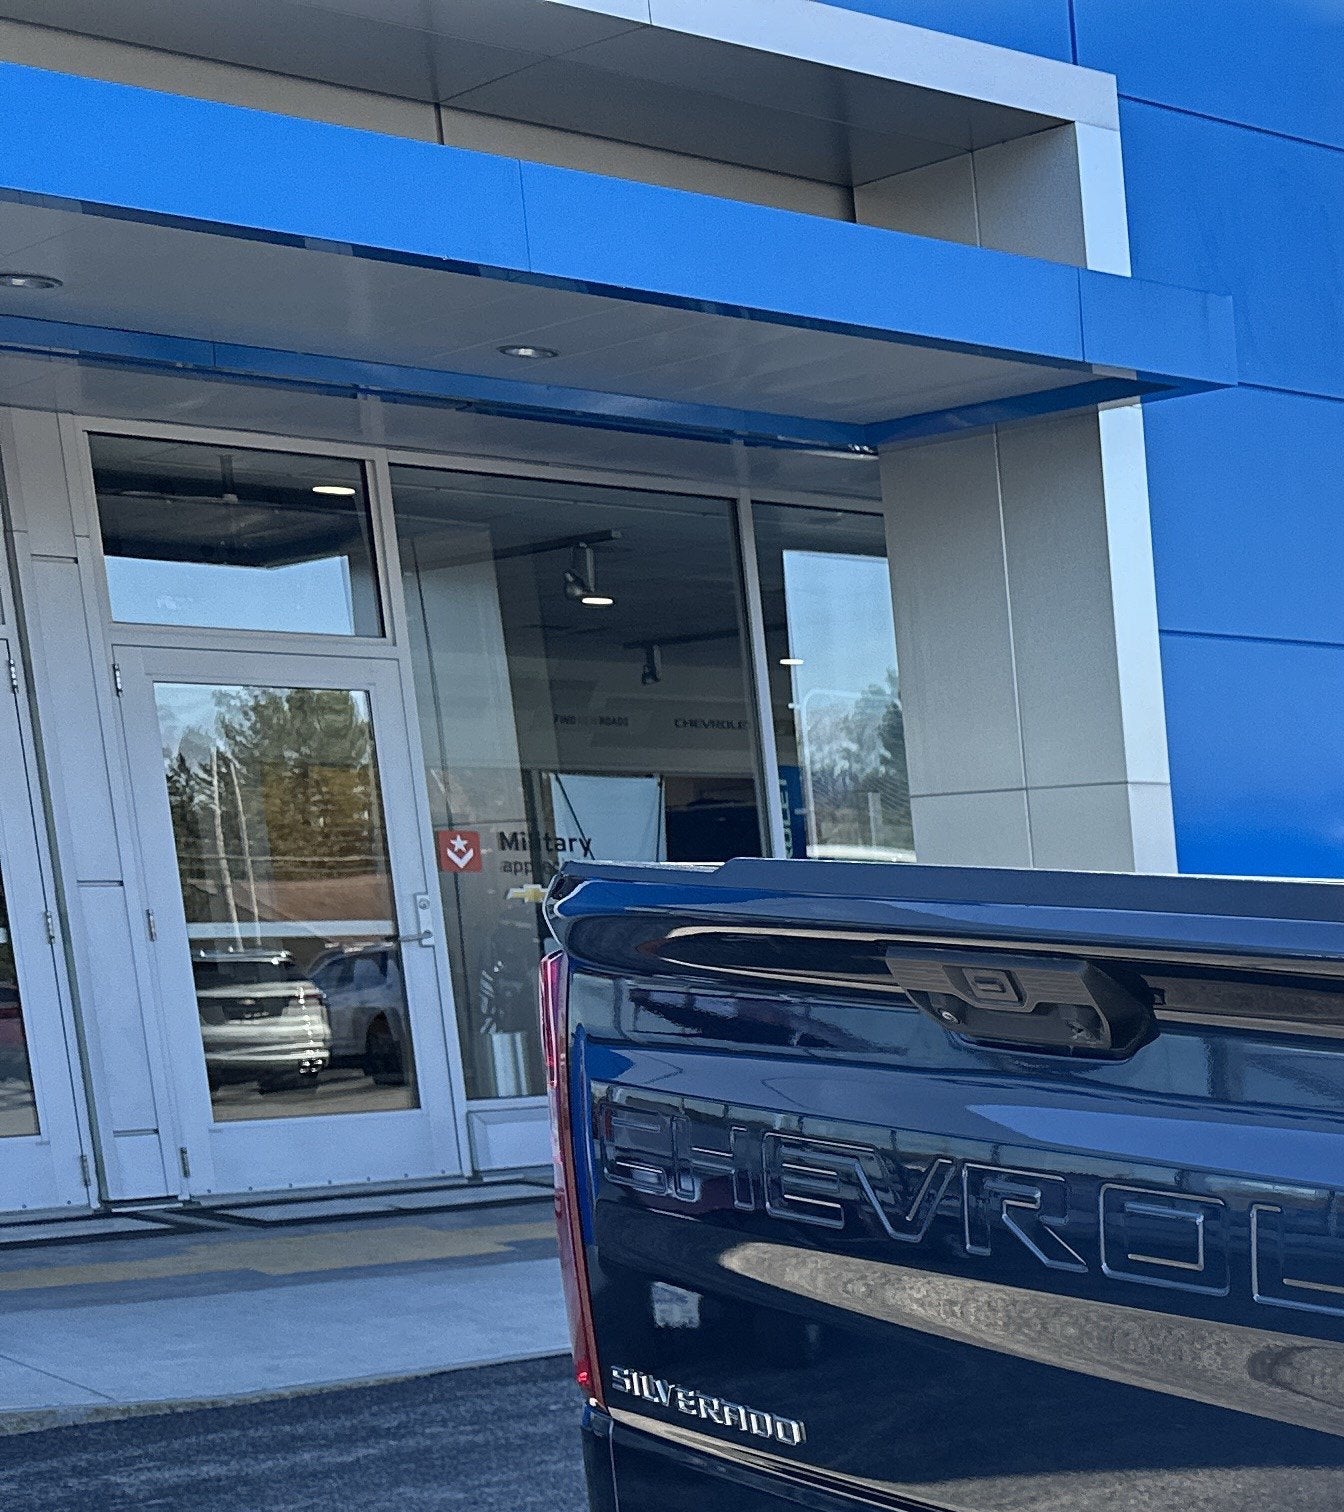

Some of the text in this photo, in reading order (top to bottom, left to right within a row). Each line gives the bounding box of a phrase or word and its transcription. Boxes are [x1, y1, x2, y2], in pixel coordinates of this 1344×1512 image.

[673, 717, 748, 730] CHEVROLE
[498, 831, 592, 857] Mitary
[610, 1365, 807, 1446] SILVERADO
